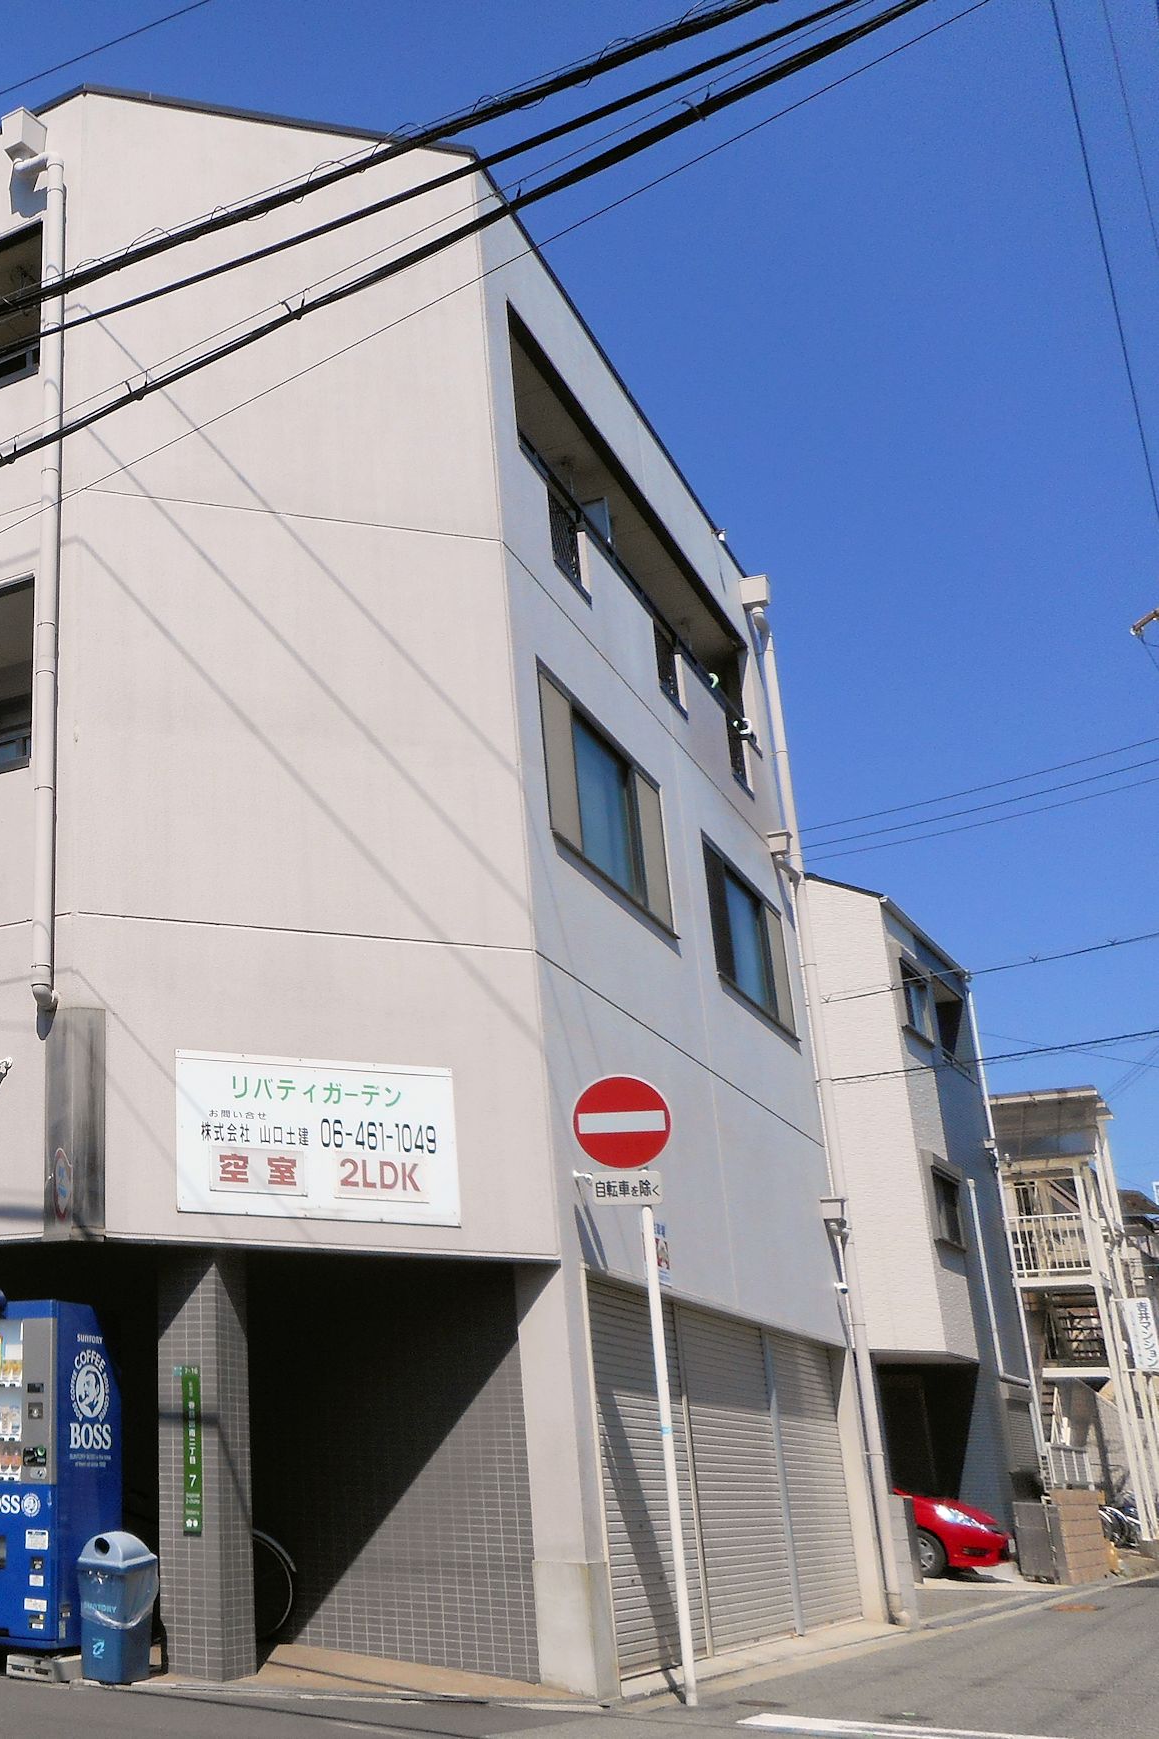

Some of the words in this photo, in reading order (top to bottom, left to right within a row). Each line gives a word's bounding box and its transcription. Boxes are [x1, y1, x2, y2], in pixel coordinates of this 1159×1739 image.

[231, 1075, 402, 1108] リバティガーデン
[208, 1109, 267, 1121] お問い合せ
[201, 1121, 251, 1143] 株式会社
[320, 1118, 437, 1155] 06-461-1049
[339, 1157, 422, 1193] 2LDK
[595, 1178, 661, 1199] 自転車を除く
[77, 1333, 103, 1345] SUNTORY
[74, 1349, 106, 1373] COFFEE
[69, 1423, 112, 1450] BOSS
[189, 1474, 197, 1488] 7
